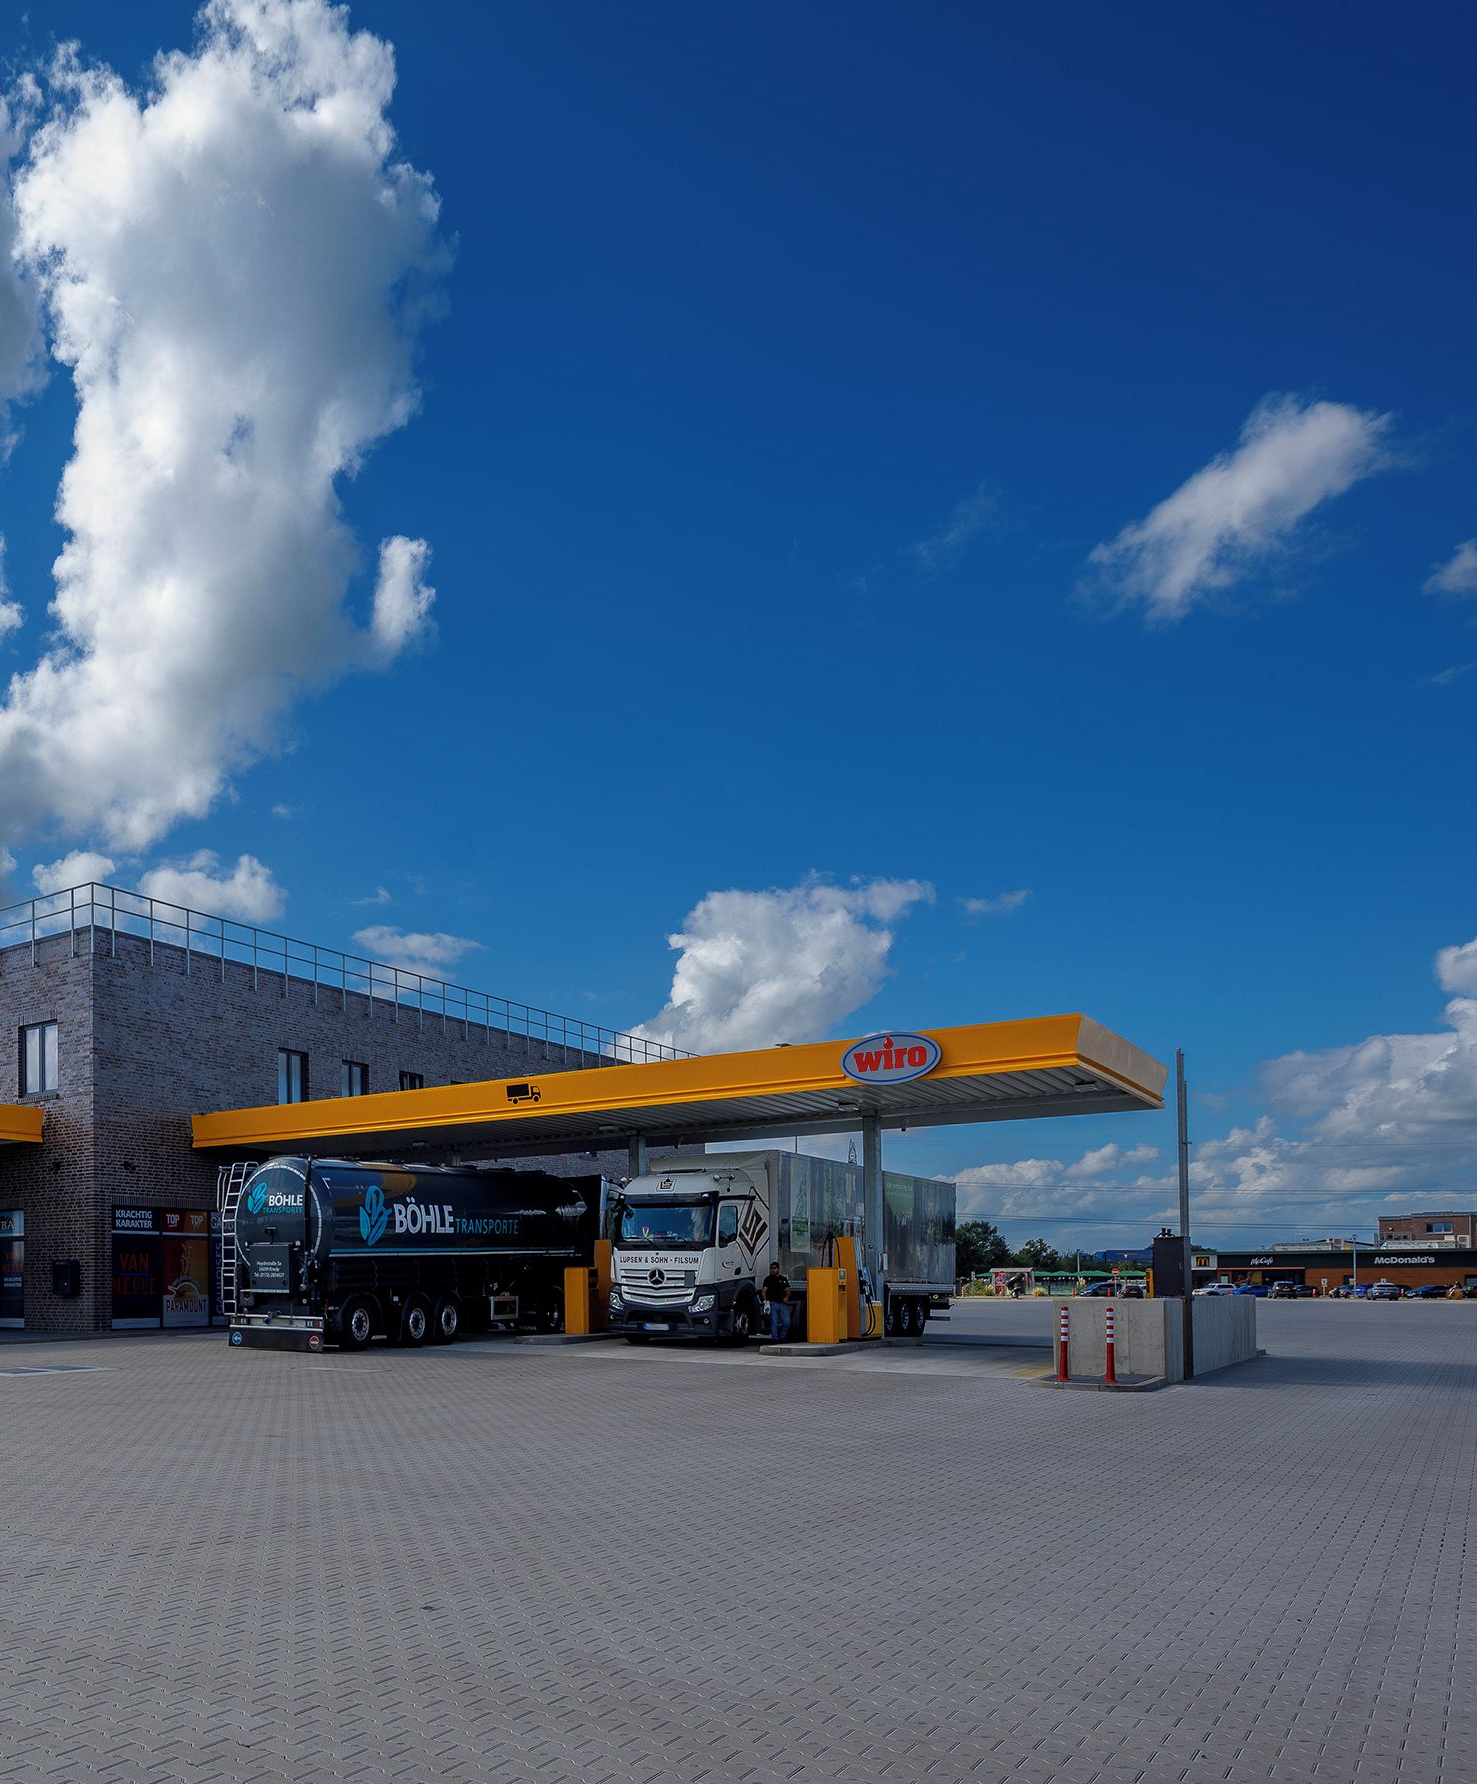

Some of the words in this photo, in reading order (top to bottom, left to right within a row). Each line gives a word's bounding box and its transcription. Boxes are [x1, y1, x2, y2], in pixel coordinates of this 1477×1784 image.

[853, 1035, 927, 1072] wiro
[268, 1192, 303, 1206] BÖHLE
[115, 1209, 152, 1219] KRACHTIG
[393, 1196, 454, 1233] BÖHLE
[455, 1218, 518, 1234] TRANSPORTE
[115, 1219, 152, 1229] KARAKTER
[119, 1253, 149, 1272] VAN
[674, 1256, 699, 1264] FILSUM
[1374, 1256, 1435, 1264] McDonald's
[112, 1277, 157, 1296] NELLE
[166, 1300, 206, 1312] PARAMOUNT
